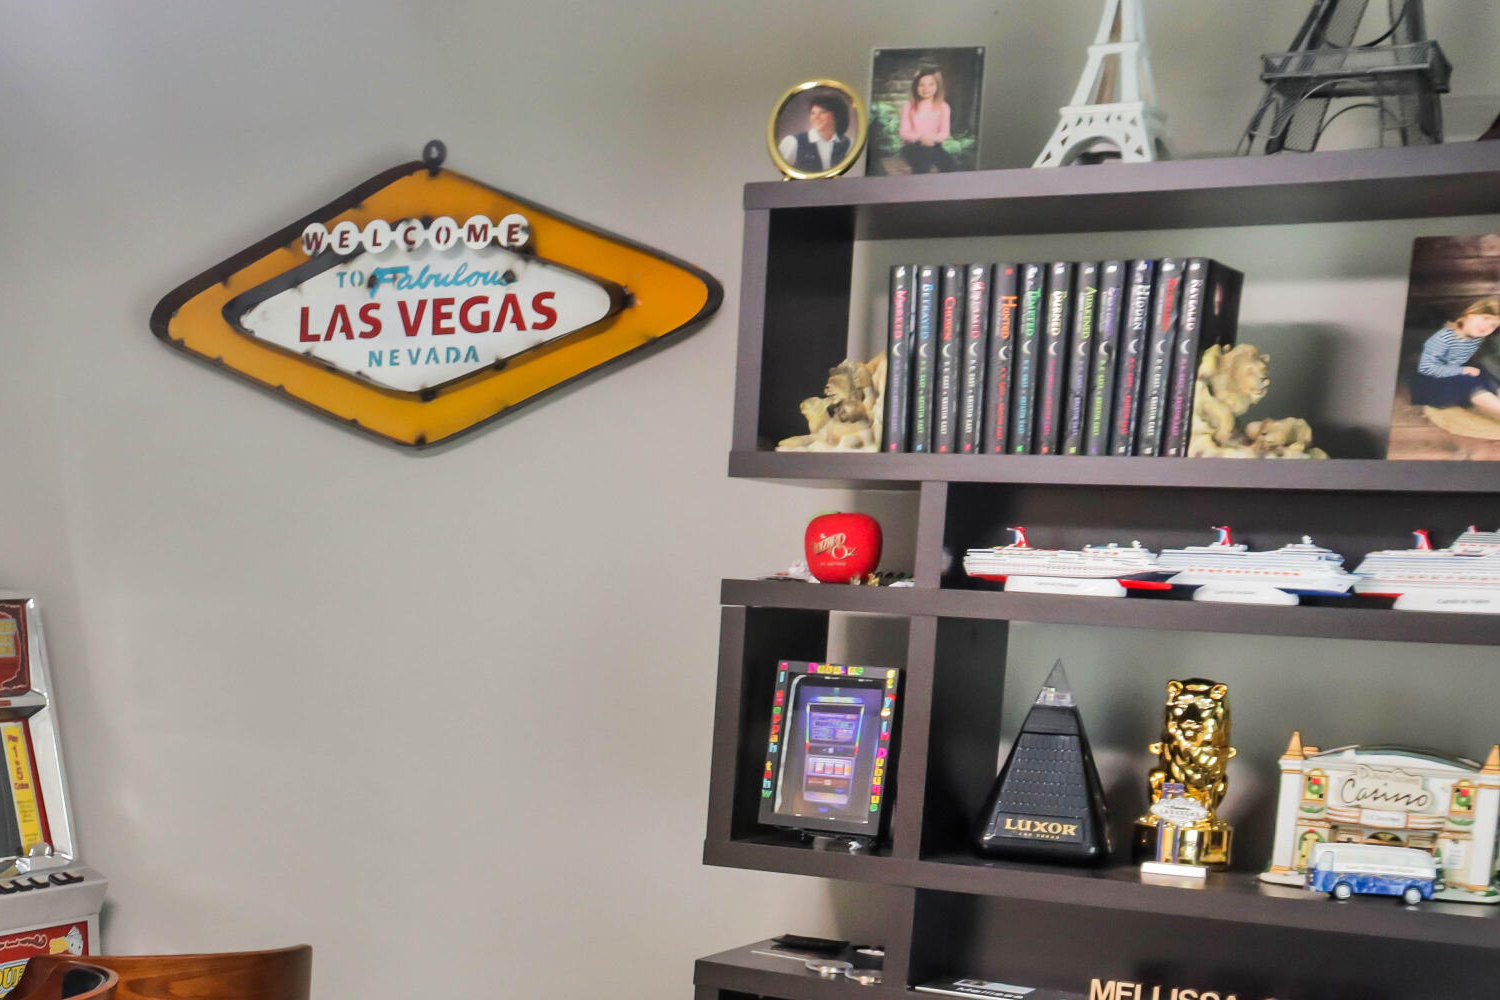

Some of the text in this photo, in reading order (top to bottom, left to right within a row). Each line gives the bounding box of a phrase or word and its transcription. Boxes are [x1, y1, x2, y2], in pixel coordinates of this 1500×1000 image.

[304, 221, 522, 252] WELCOME
[336, 269, 364, 289] TO
[299, 291, 559, 344] LAS VEGAS
[368, 344, 479, 368] NEVADA
[1341, 778, 1428, 807] Casino
[1004, 817, 1078, 836] LUXOR
